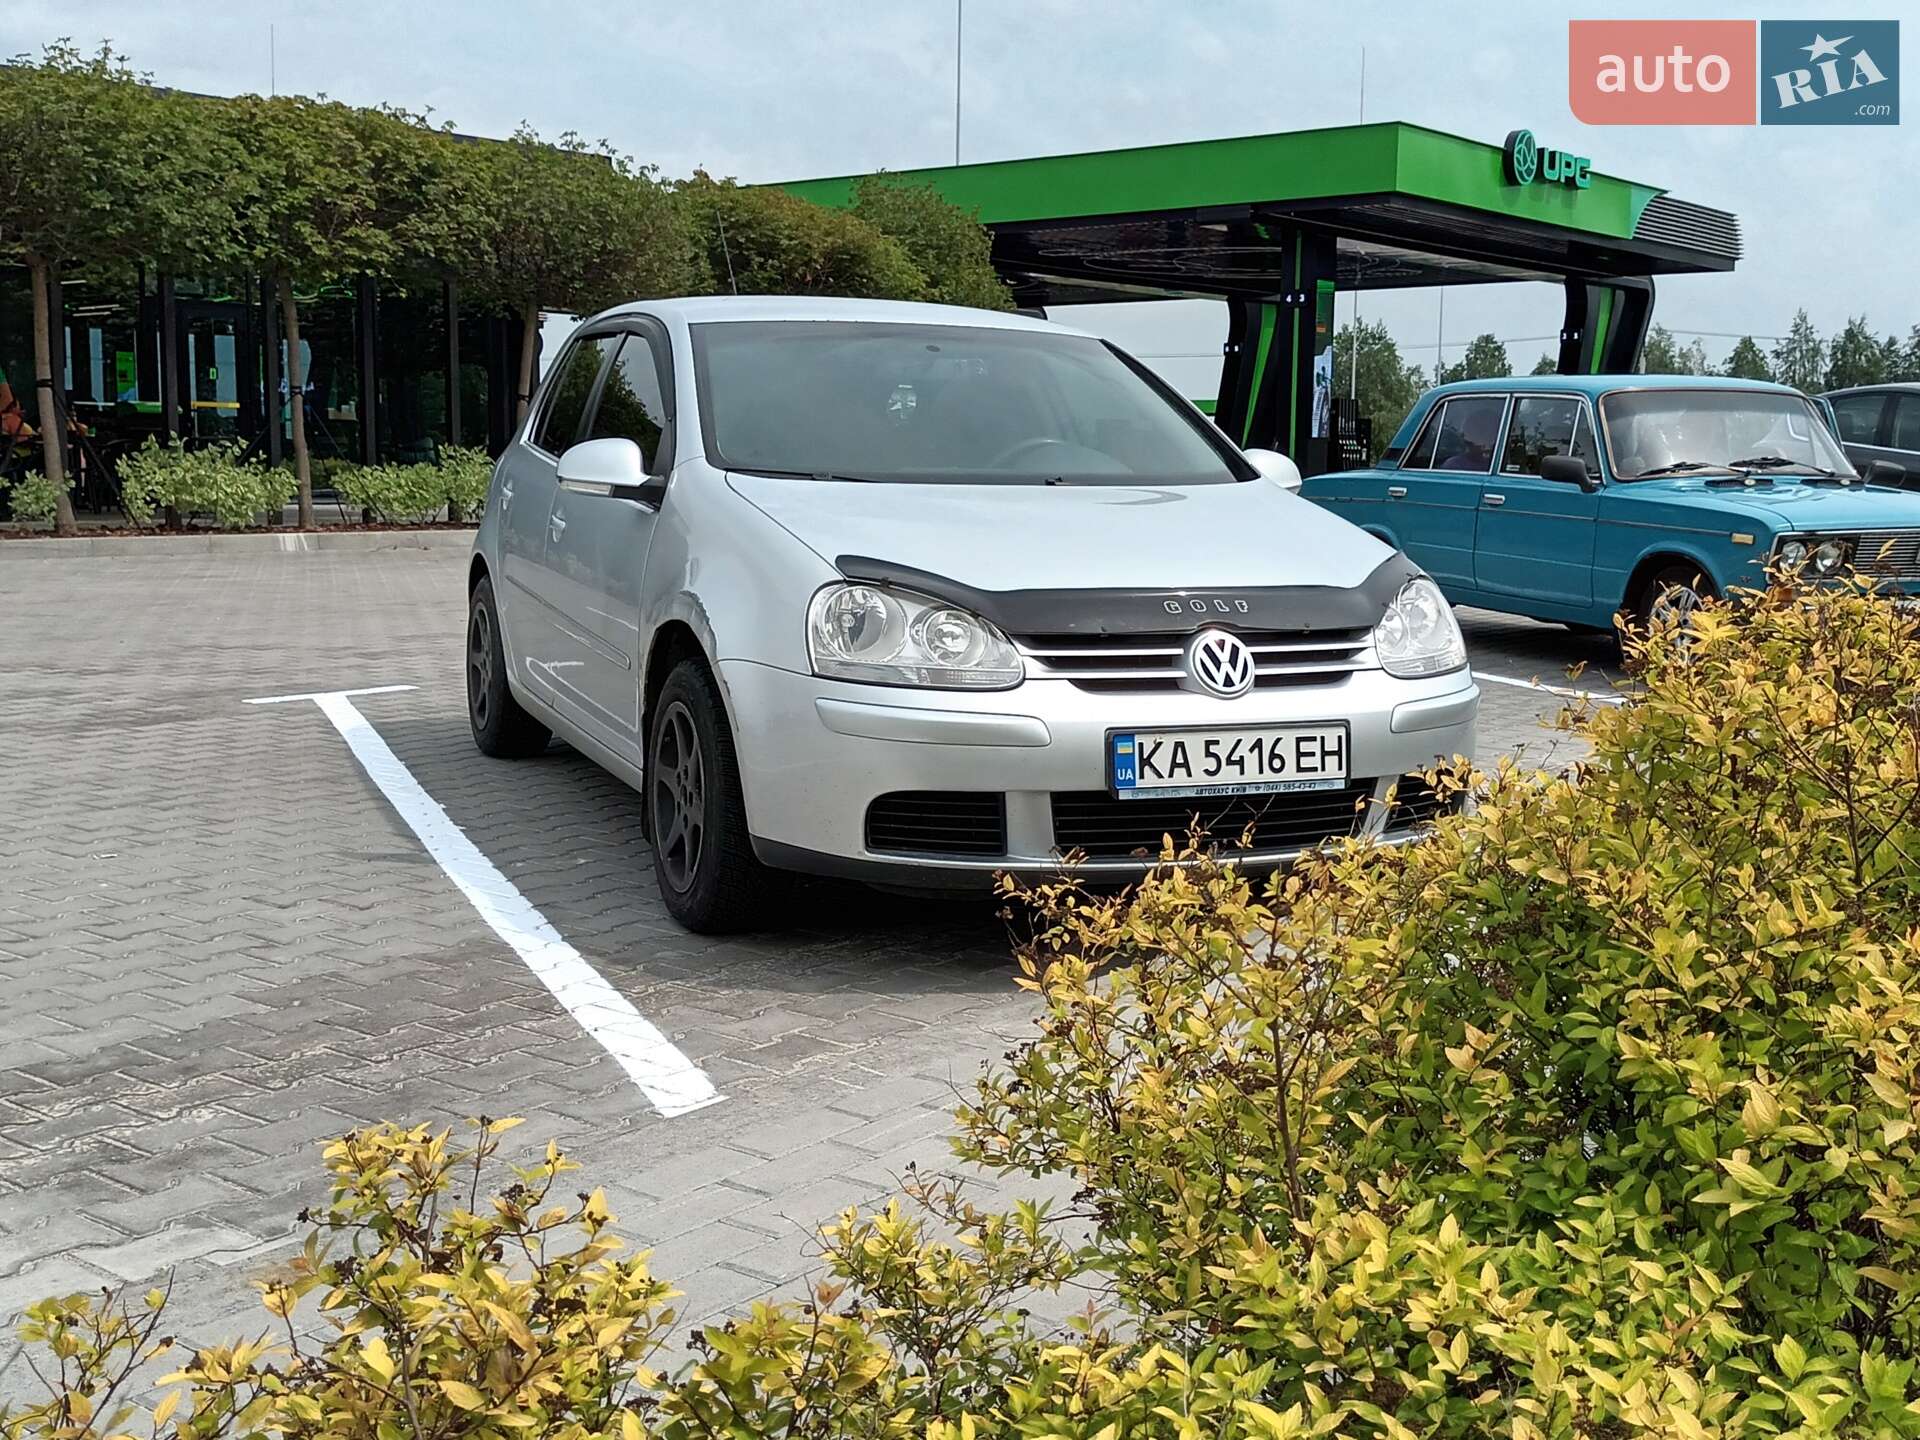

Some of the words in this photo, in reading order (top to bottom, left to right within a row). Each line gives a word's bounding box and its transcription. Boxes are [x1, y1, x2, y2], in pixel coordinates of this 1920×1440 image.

[1541, 147, 1591, 188] UPG
[1163, 599, 1249, 613] GOLF
[1117, 769, 1134, 781] UA
[1138, 740, 1193, 780] KA
[1202, 737, 1286, 777] 5416
[1295, 734, 1343, 773] EH
